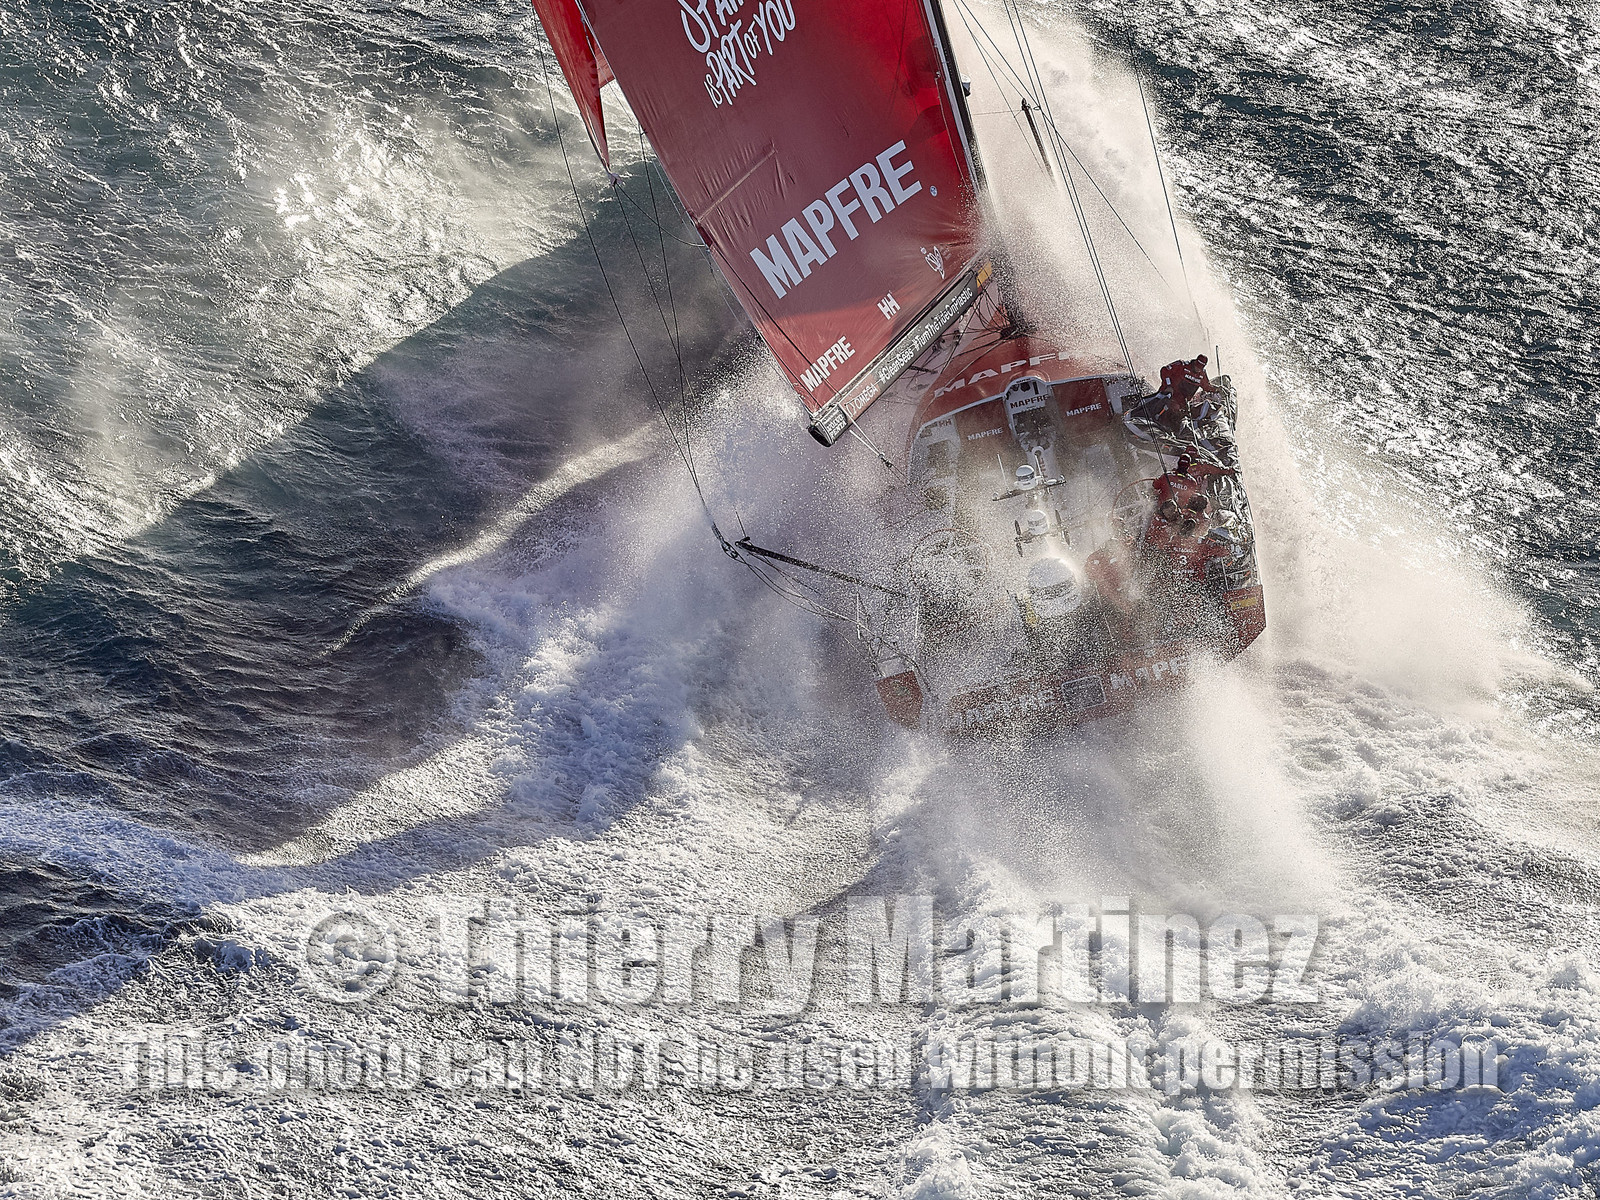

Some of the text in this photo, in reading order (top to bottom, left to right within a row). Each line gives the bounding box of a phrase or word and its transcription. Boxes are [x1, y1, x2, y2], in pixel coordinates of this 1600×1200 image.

[743, 20, 762, 59] OF
[706, 19, 757, 105] PART
[704, 73, 723, 108] IS
[749, 139, 922, 299] MAPFRE
[877, 292, 900, 320] HH
[800, 336, 856, 392] MAPFRE
[1009, 393, 1049, 409] MAPFRE
[1066, 402, 1102, 417] MAPFRE
[967, 427, 1003, 441] MAPFRE
